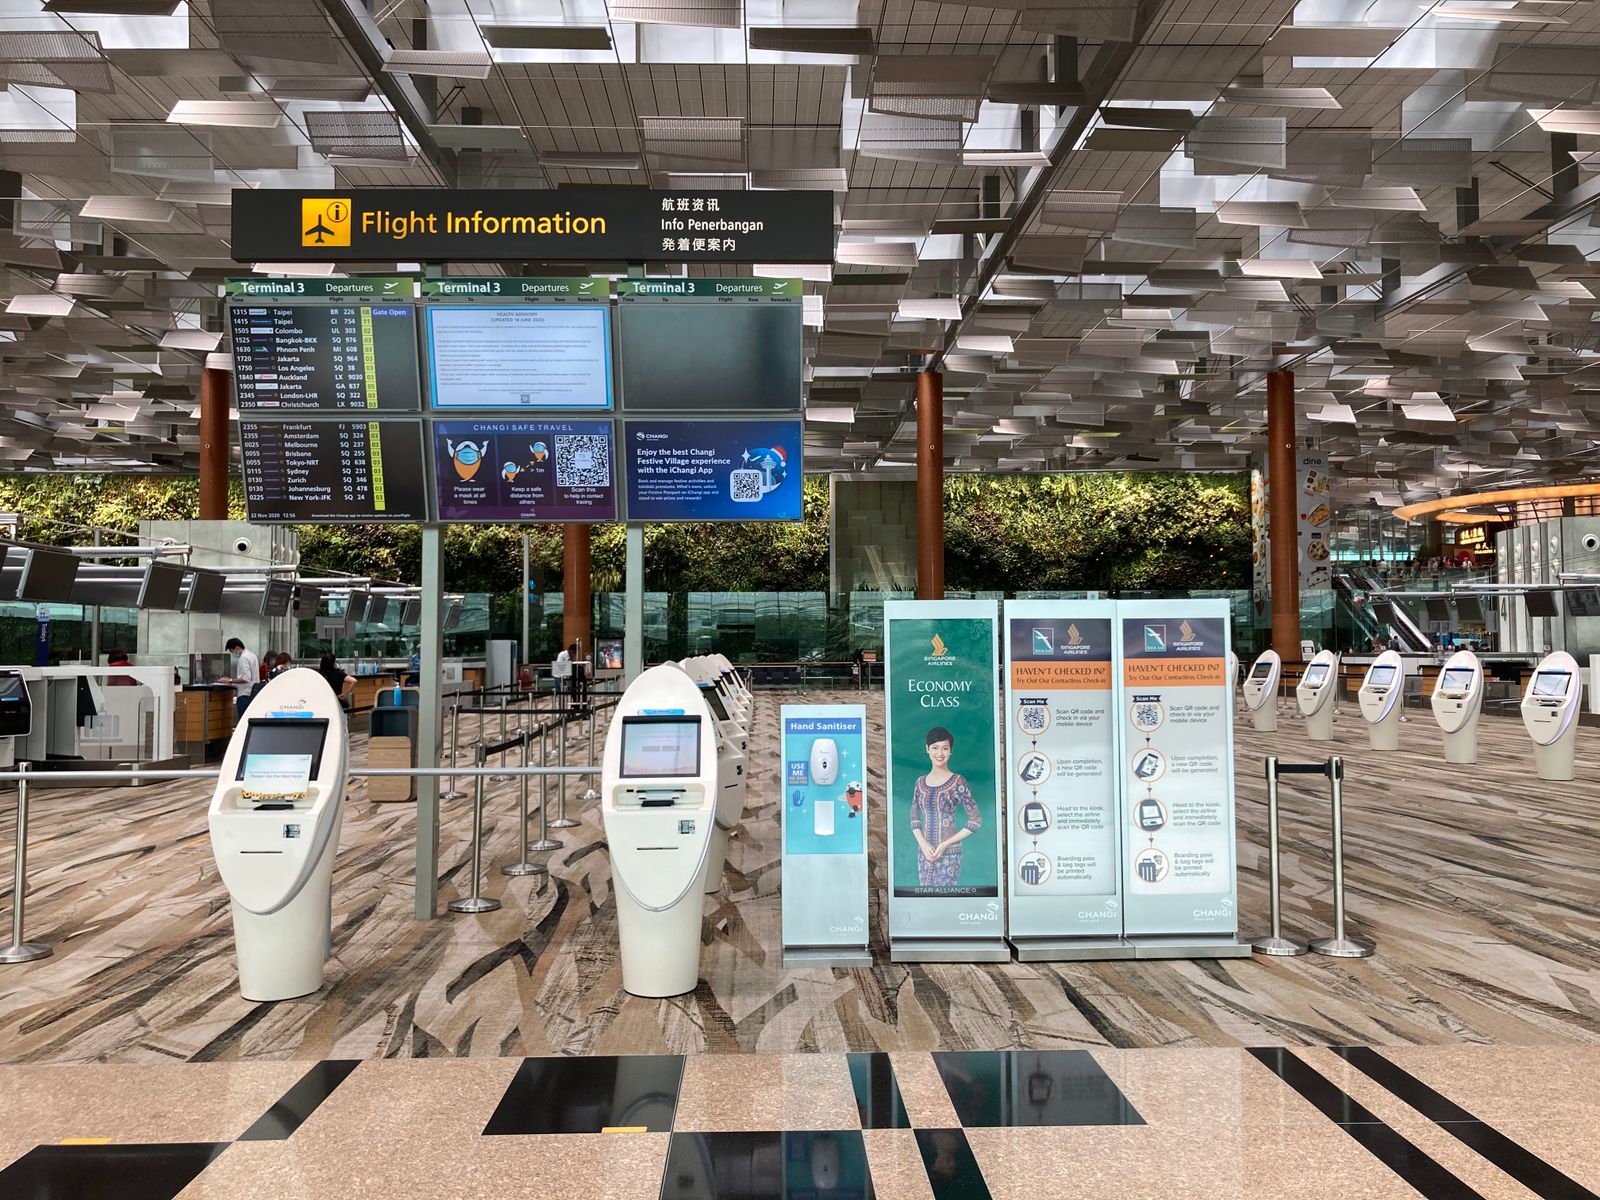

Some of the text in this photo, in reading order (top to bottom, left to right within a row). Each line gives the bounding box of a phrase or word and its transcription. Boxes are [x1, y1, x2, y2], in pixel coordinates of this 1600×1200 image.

[661, 198, 720, 212] 航班资讯
[361, 210, 607, 240] Flight Information
[661, 218, 764, 234] Info Penerbangan
[661, 237, 736, 251] 発着便案内
[241, 282, 374, 293] Terminal 3 Departures
[437, 282, 570, 293] Terminal 3 Departures
[632, 282, 763, 293] Terminal 3 Departures
[637, 448, 658, 457] Enjoy
[690, 448, 715, 456] Changi
[908, 679, 972, 692] ECONOMY
[920, 694, 960, 707] CLASS
[790, 722, 856, 730] Hand Sanitiser
[958, 912, 998, 921] CHANGI
